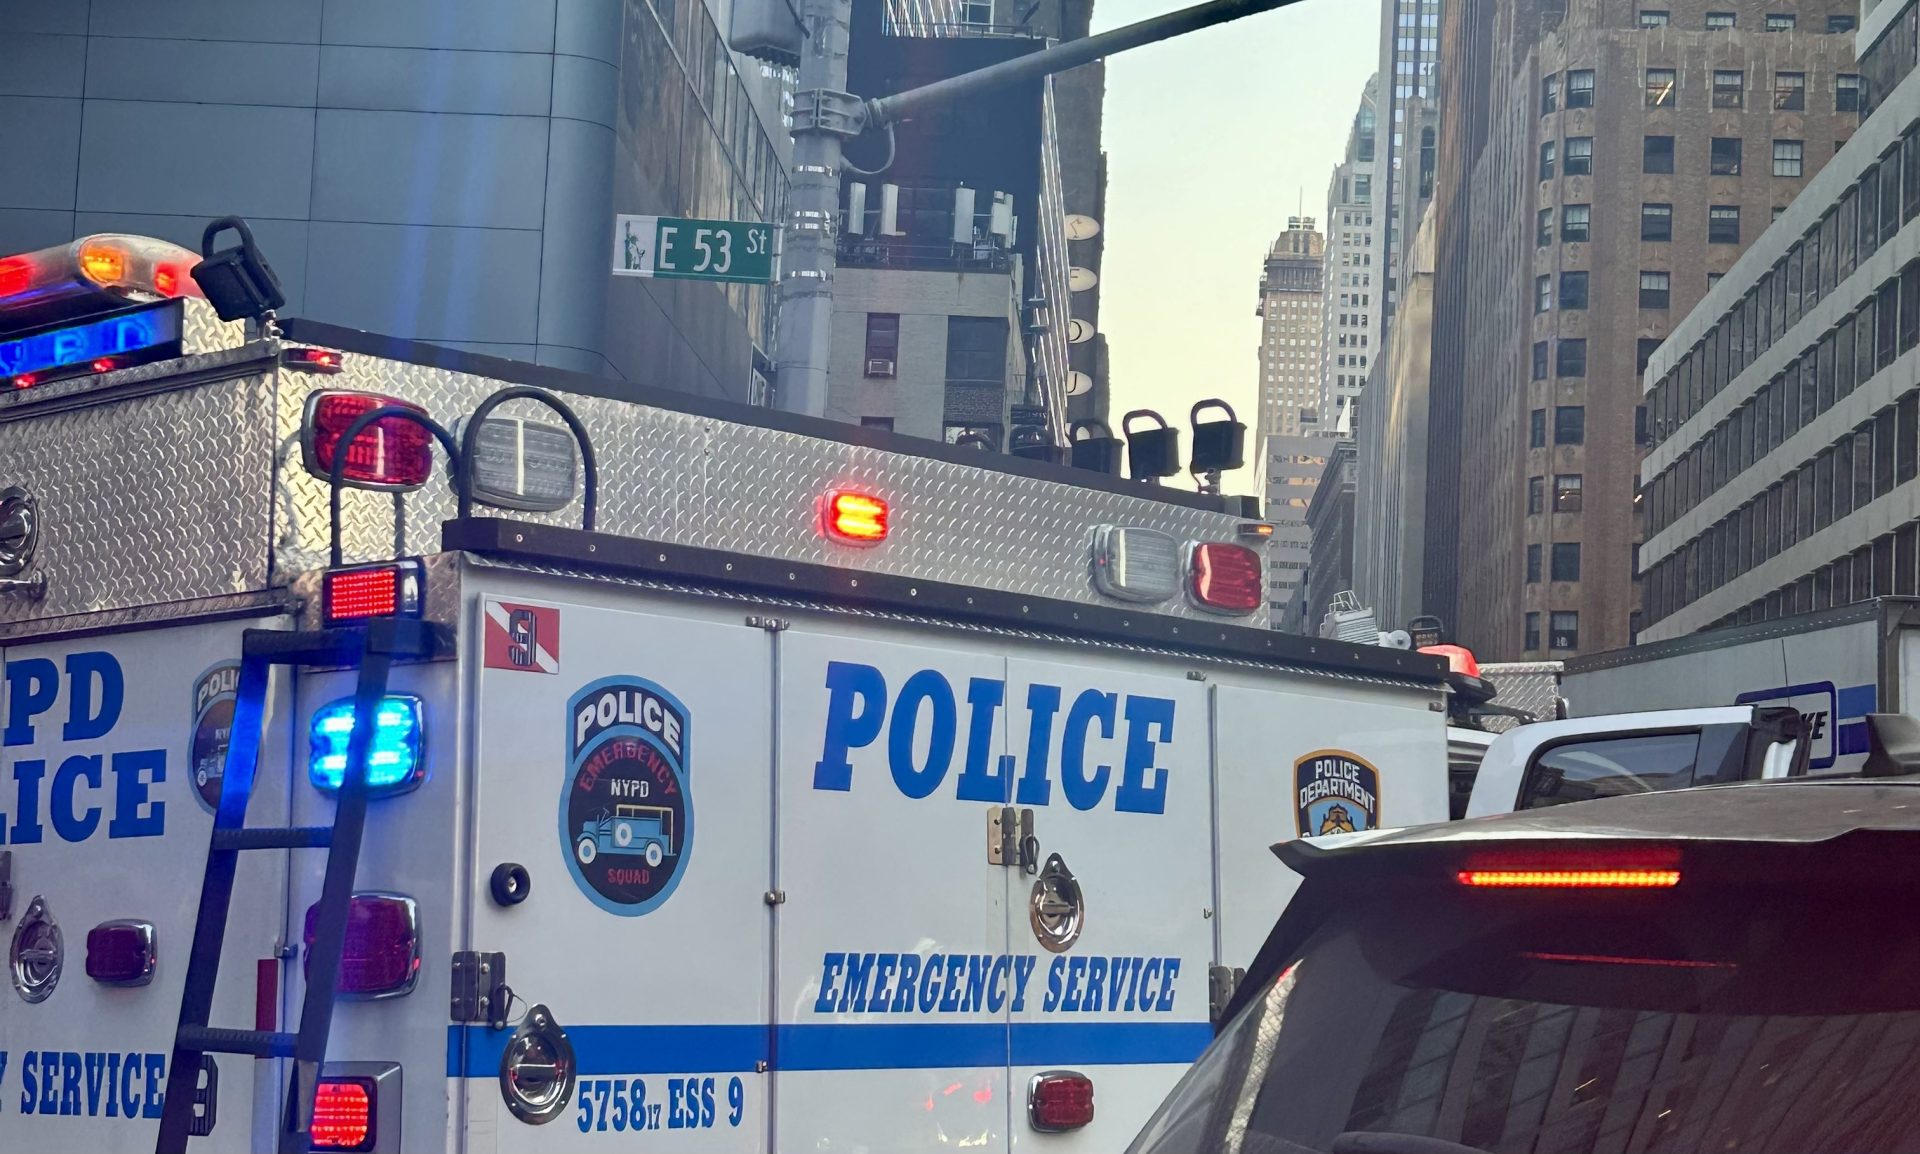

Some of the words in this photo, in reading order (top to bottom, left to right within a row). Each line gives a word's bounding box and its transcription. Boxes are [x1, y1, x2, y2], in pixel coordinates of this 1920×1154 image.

[659, 226, 678, 269] E
[693, 229, 732, 273] 53
[746, 228, 767, 254] St
[197, 670, 241, 713] POLI
[577, 690, 681, 755] POLICE
[813, 660, 1176, 815] POLICE
[579, 741, 677, 797] EMERGENCY
[611, 778, 649, 798] NYPD
[1315, 759, 1360, 784] POLICE
[0, 749, 167, 845] ICE
[1300, 778, 1375, 814] DEPARTMENT
[608, 868, 650, 885] SQUAD
[814, 952, 1036, 1014] EMERGENCY
[1043, 955, 1181, 1012] SERVICE
[20, 1051, 166, 1119] SERVICE
[668, 1077, 715, 1128] ESS
[728, 1076, 744, 1127] 9
